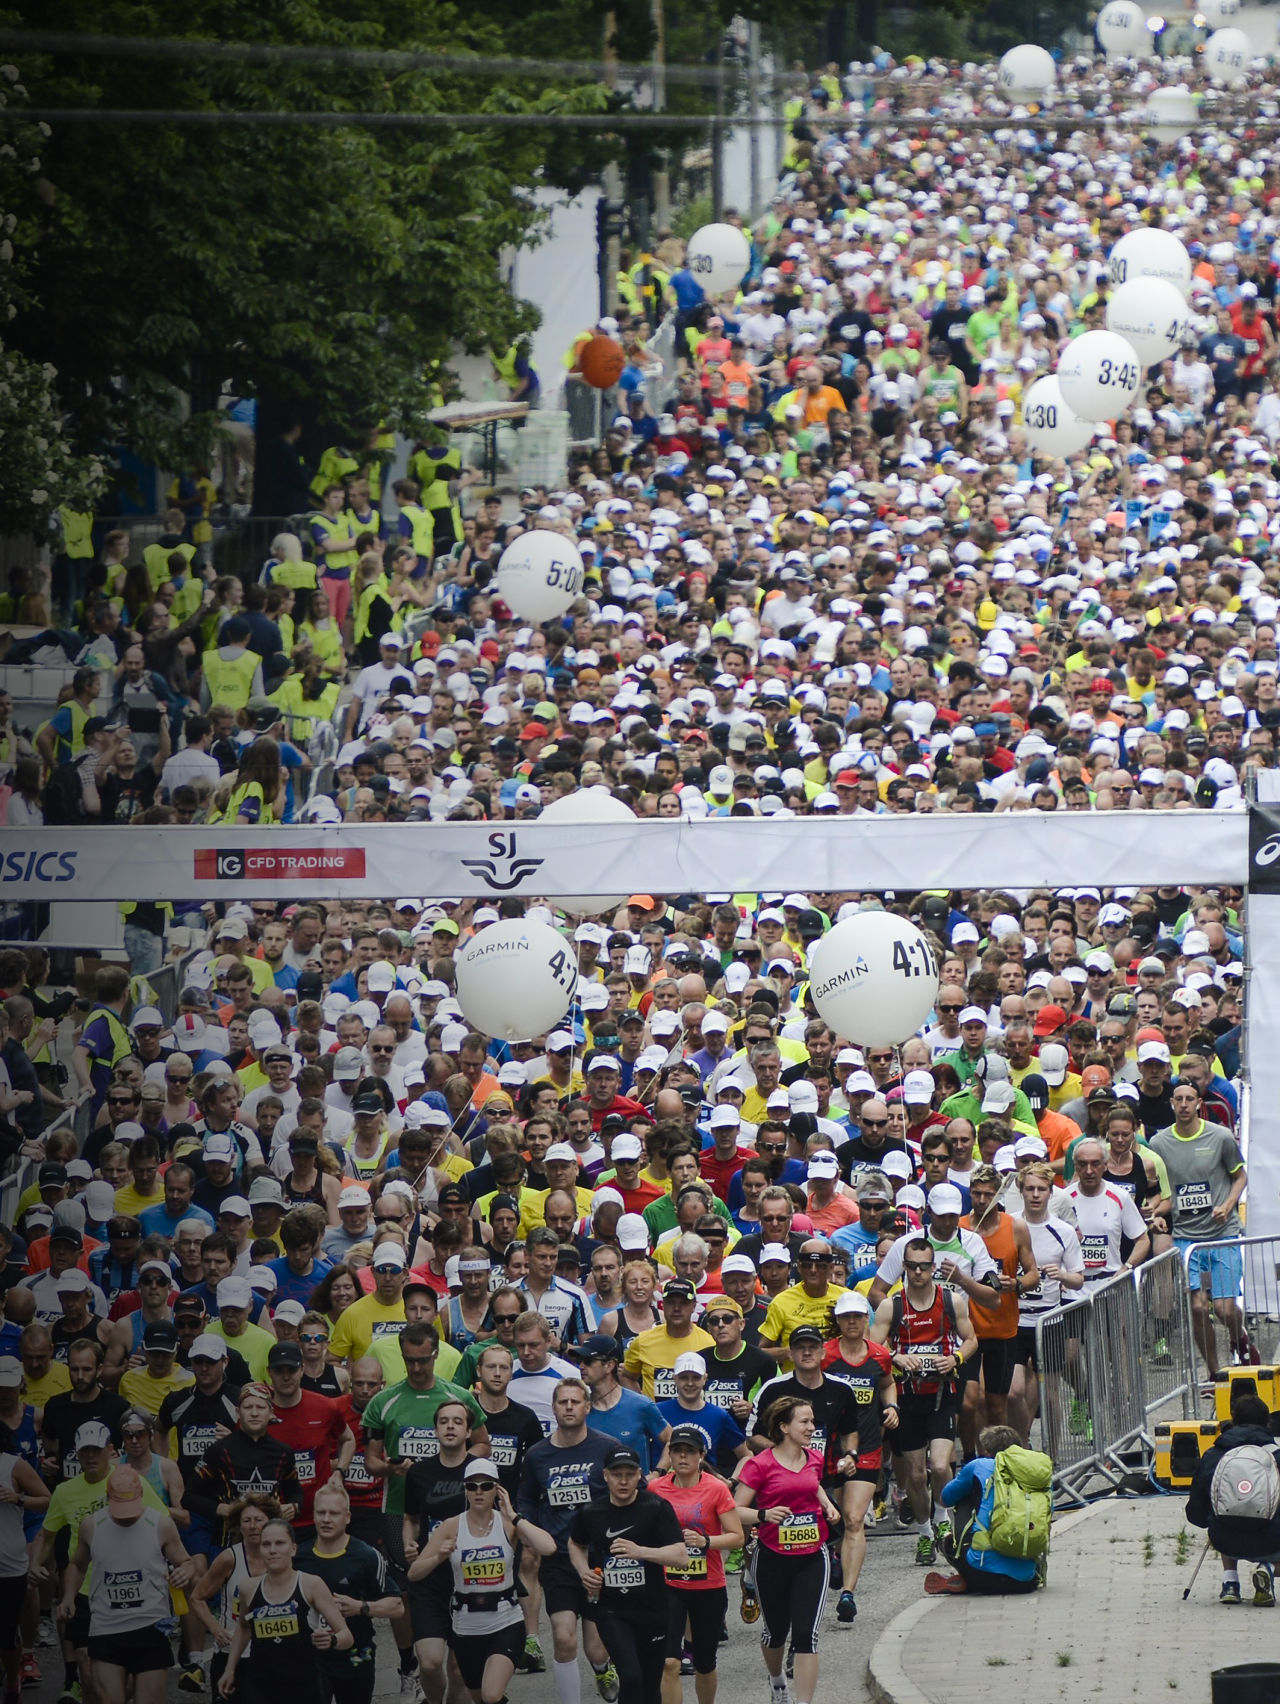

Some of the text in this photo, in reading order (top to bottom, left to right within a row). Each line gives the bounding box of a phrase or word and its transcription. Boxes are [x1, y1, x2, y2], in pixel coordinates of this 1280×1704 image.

[1098, 358, 1139, 391] 3:45
[1024, 405, 1057, 429] 4:30
[488, 832, 517, 860] SJ
[217, 855, 346, 876] IG CFD TRADING
[467, 940, 530, 961] GARMIN
[815, 963, 869, 999] GARMIN
[1180, 1195, 1209, 1208] 18481
[402, 1442, 438, 1455] 11823
[551, 1489, 588, 1503] 12515
[782, 1528, 817, 1542] 15688
[465, 1562, 504, 1576] 15173
[606, 1571, 643, 1585] 11959
[106, 1587, 142, 1601] 11961
[258, 1621, 296, 1636] 16461
